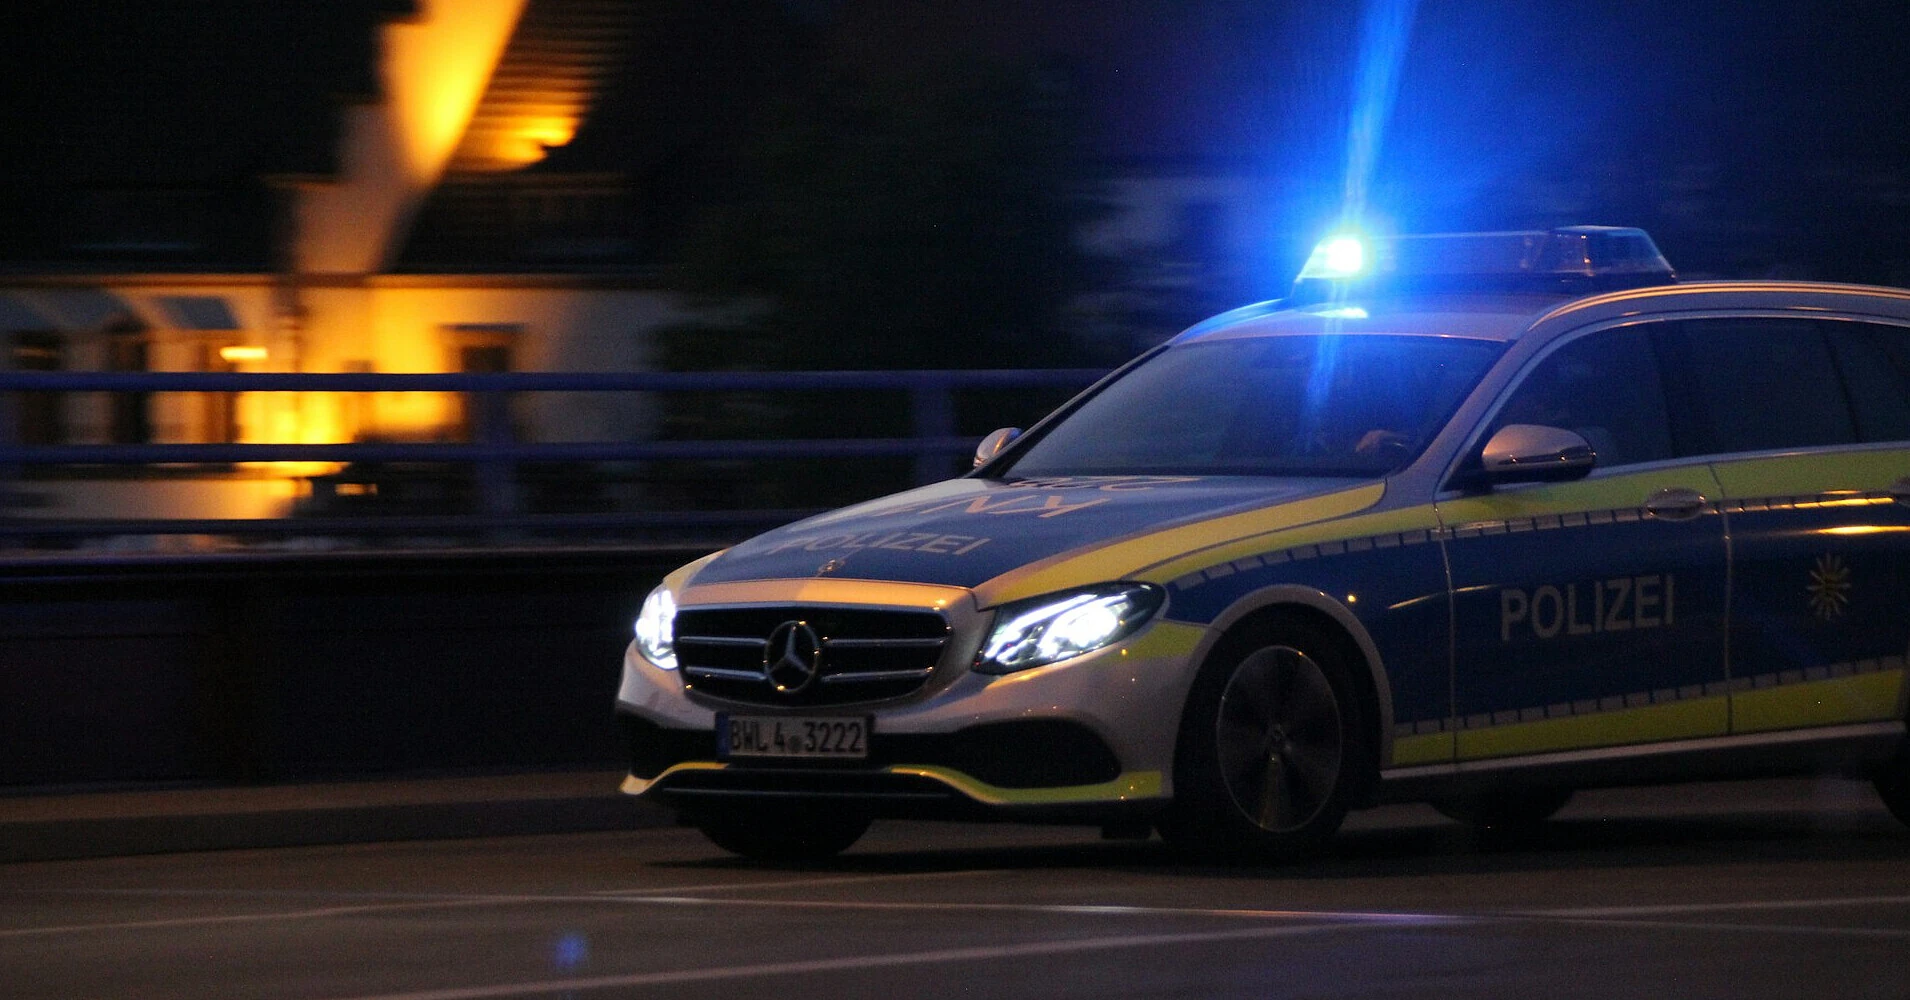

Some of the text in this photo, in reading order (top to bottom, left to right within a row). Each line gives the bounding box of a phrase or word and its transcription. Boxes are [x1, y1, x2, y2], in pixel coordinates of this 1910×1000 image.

[765, 531, 992, 556] POLIZEI
[1500, 573, 1676, 642] POLIZEI
[730, 719, 862, 753] BWL 4 3222
